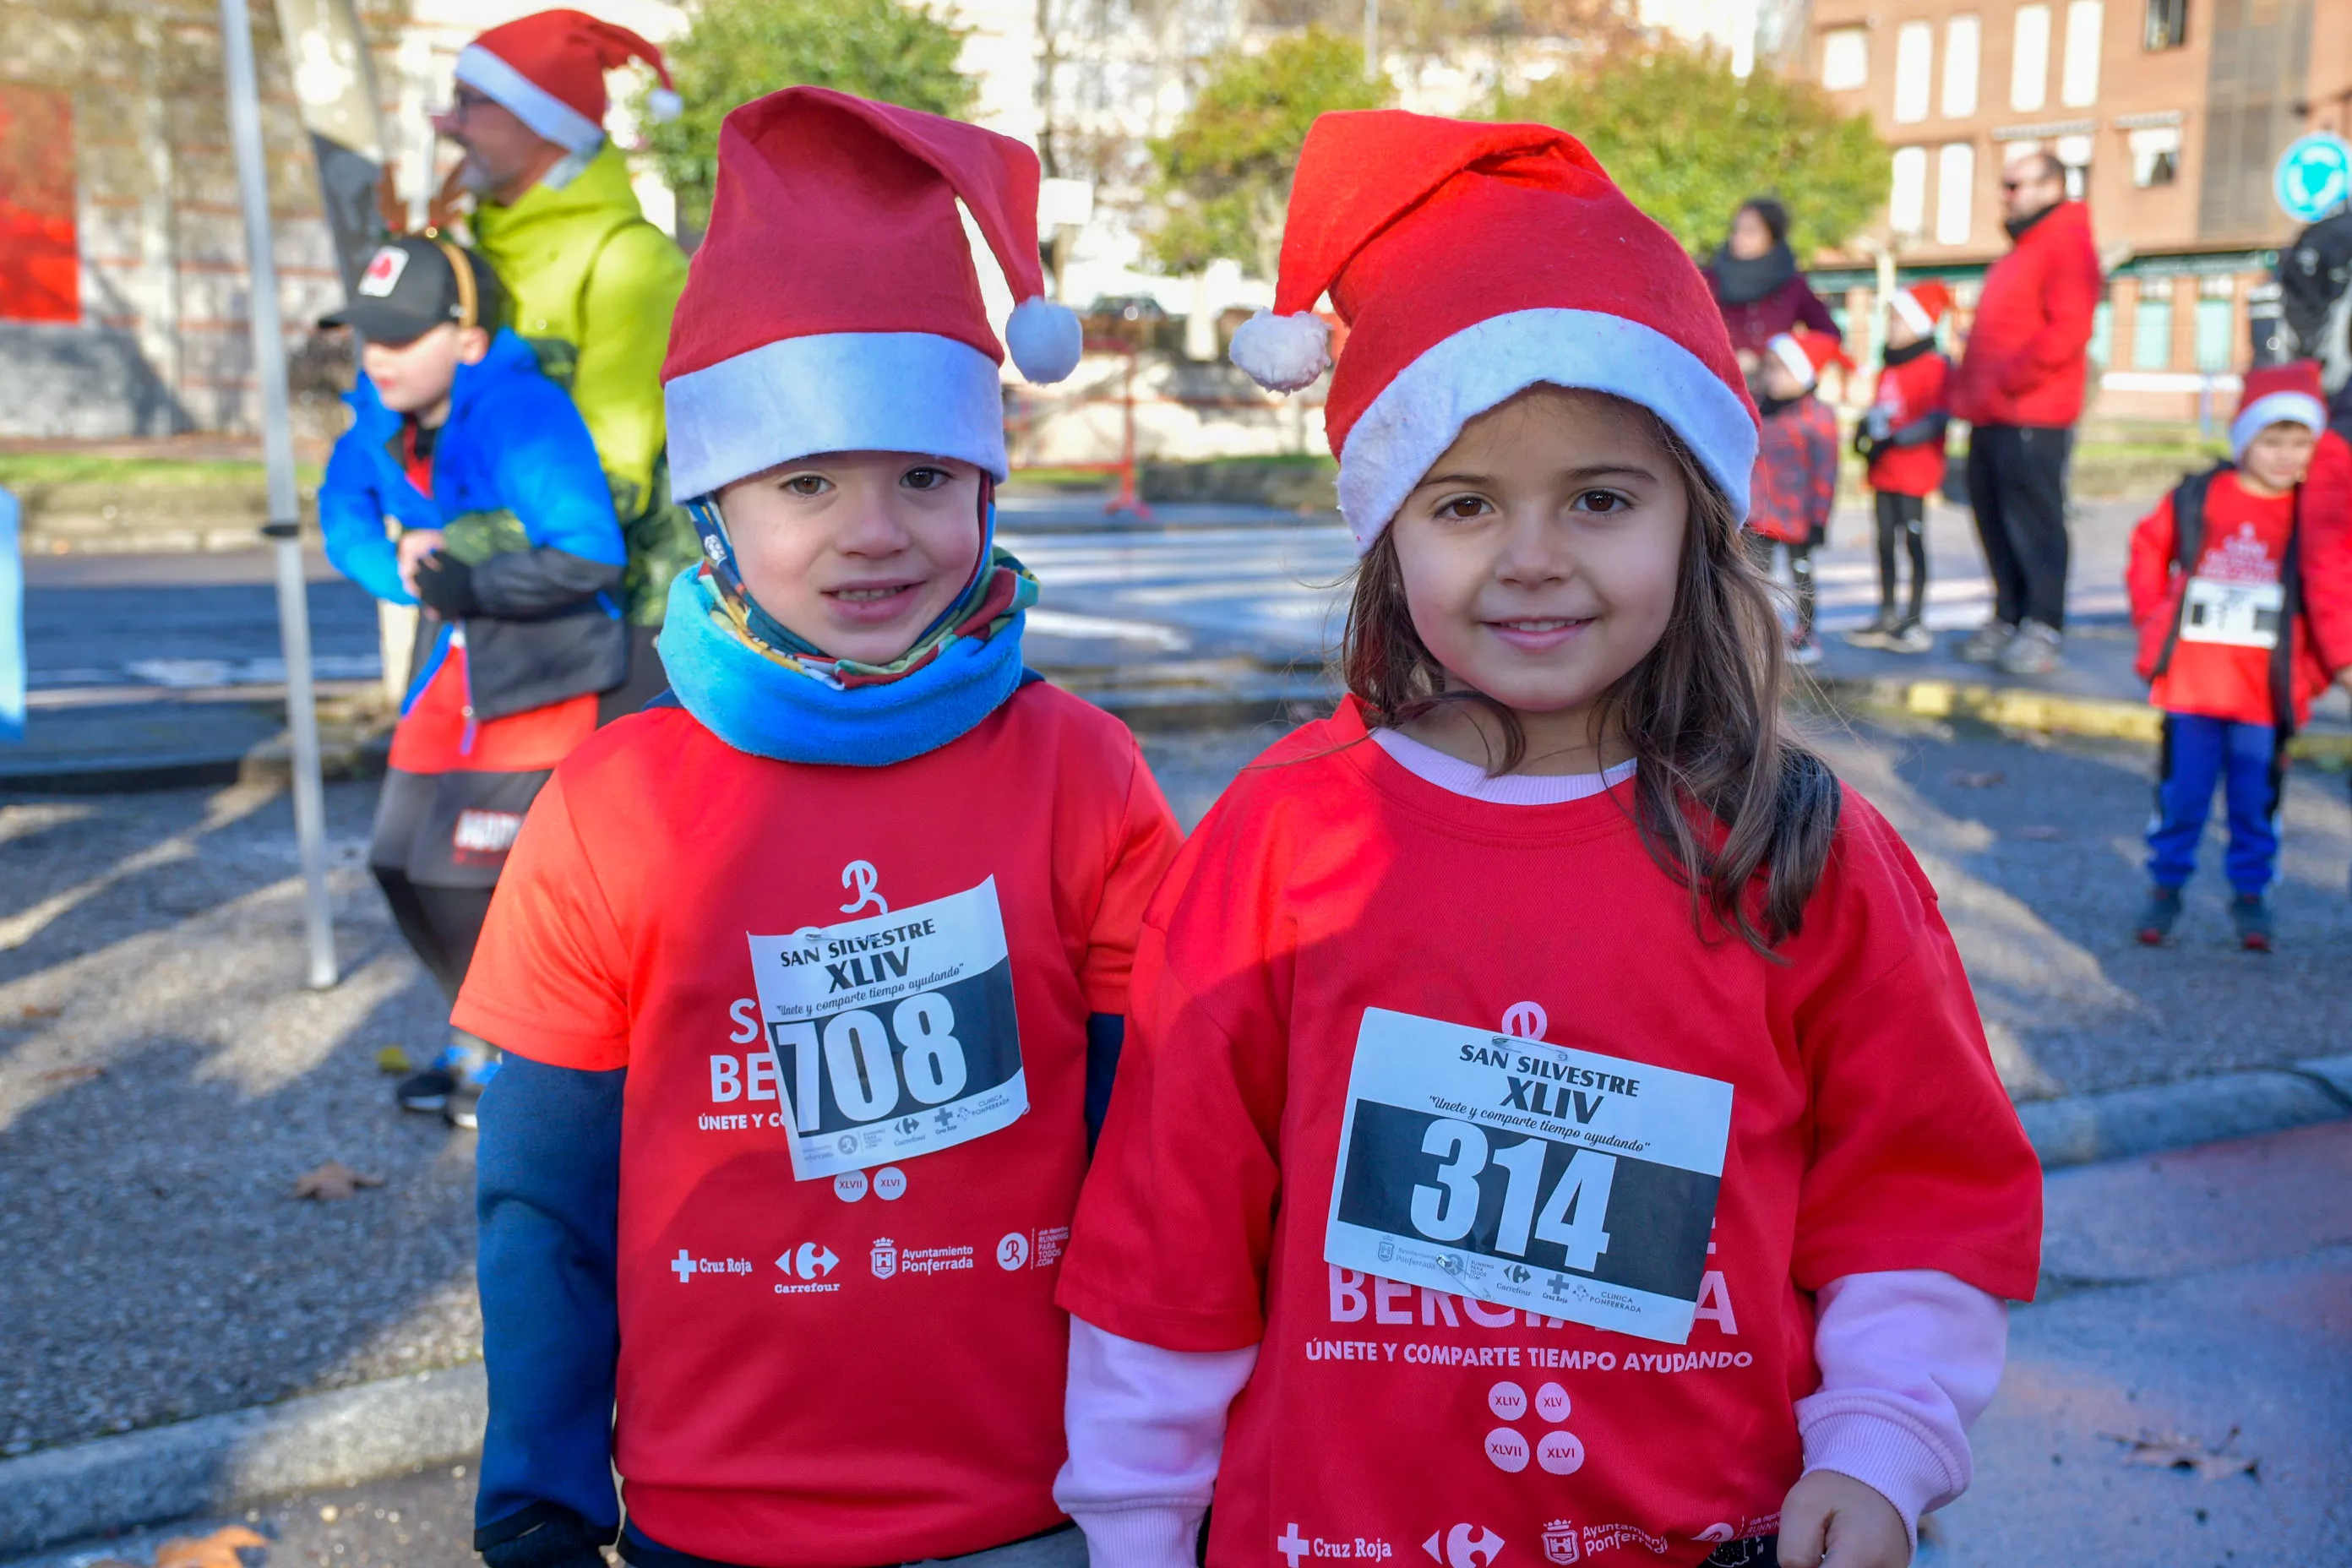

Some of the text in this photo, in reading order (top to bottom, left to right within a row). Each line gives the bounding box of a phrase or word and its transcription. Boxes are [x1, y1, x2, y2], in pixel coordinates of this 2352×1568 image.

[781, 917, 936, 967] SAN SILVESTRE
[825, 945, 910, 994] XLIV
[806, 1004, 813, 1017] y
[816, 992, 867, 1011] comparte
[869, 982, 905, 999] tiempo
[776, 992, 967, 1133] 708
[1459, 1044, 1640, 1097] SAN SILVESTRE
[1499, 1075, 1604, 1124] XLIV
[698, 1112, 748, 1130] ÚNETE
[751, 1113, 764, 1128] Y
[1467, 1107, 1478, 1120] y
[1481, 1108, 1538, 1129] comparte
[1540, 1119, 1580, 1139] tiempo
[1584, 1131, 1651, 1152] ayudando"
[839, 1179, 863, 1190] XLVII
[880, 1179, 901, 1188] XLVI
[1410, 1118, 1618, 1272] 314
[902, 1245, 974, 1260] Ayuntamiento
[1396, 1254, 1435, 1270] Ponferrada
[700, 1258, 753, 1277] Cruz Roja
[901, 1256, 974, 1276] Ponferrada
[774, 1282, 841, 1293] Carrefour
[1496, 1282, 1532, 1296] Carrefour
[1542, 1293, 1568, 1304] Cruz Roja
[1589, 1295, 1642, 1314] PONFERRADA
[1306, 1337, 1753, 1373] ÚNETE Y COMPARTE TIEMPO AYUDANDO
[1495, 1396, 1520, 1406] XLIV
[1544, 1396, 1562, 1407] XLV
[1490, 1443, 1522, 1456] XLVII
[1547, 1448, 1575, 1458] XLVI
[1313, 1538, 1392, 1562] Cruz Roja
